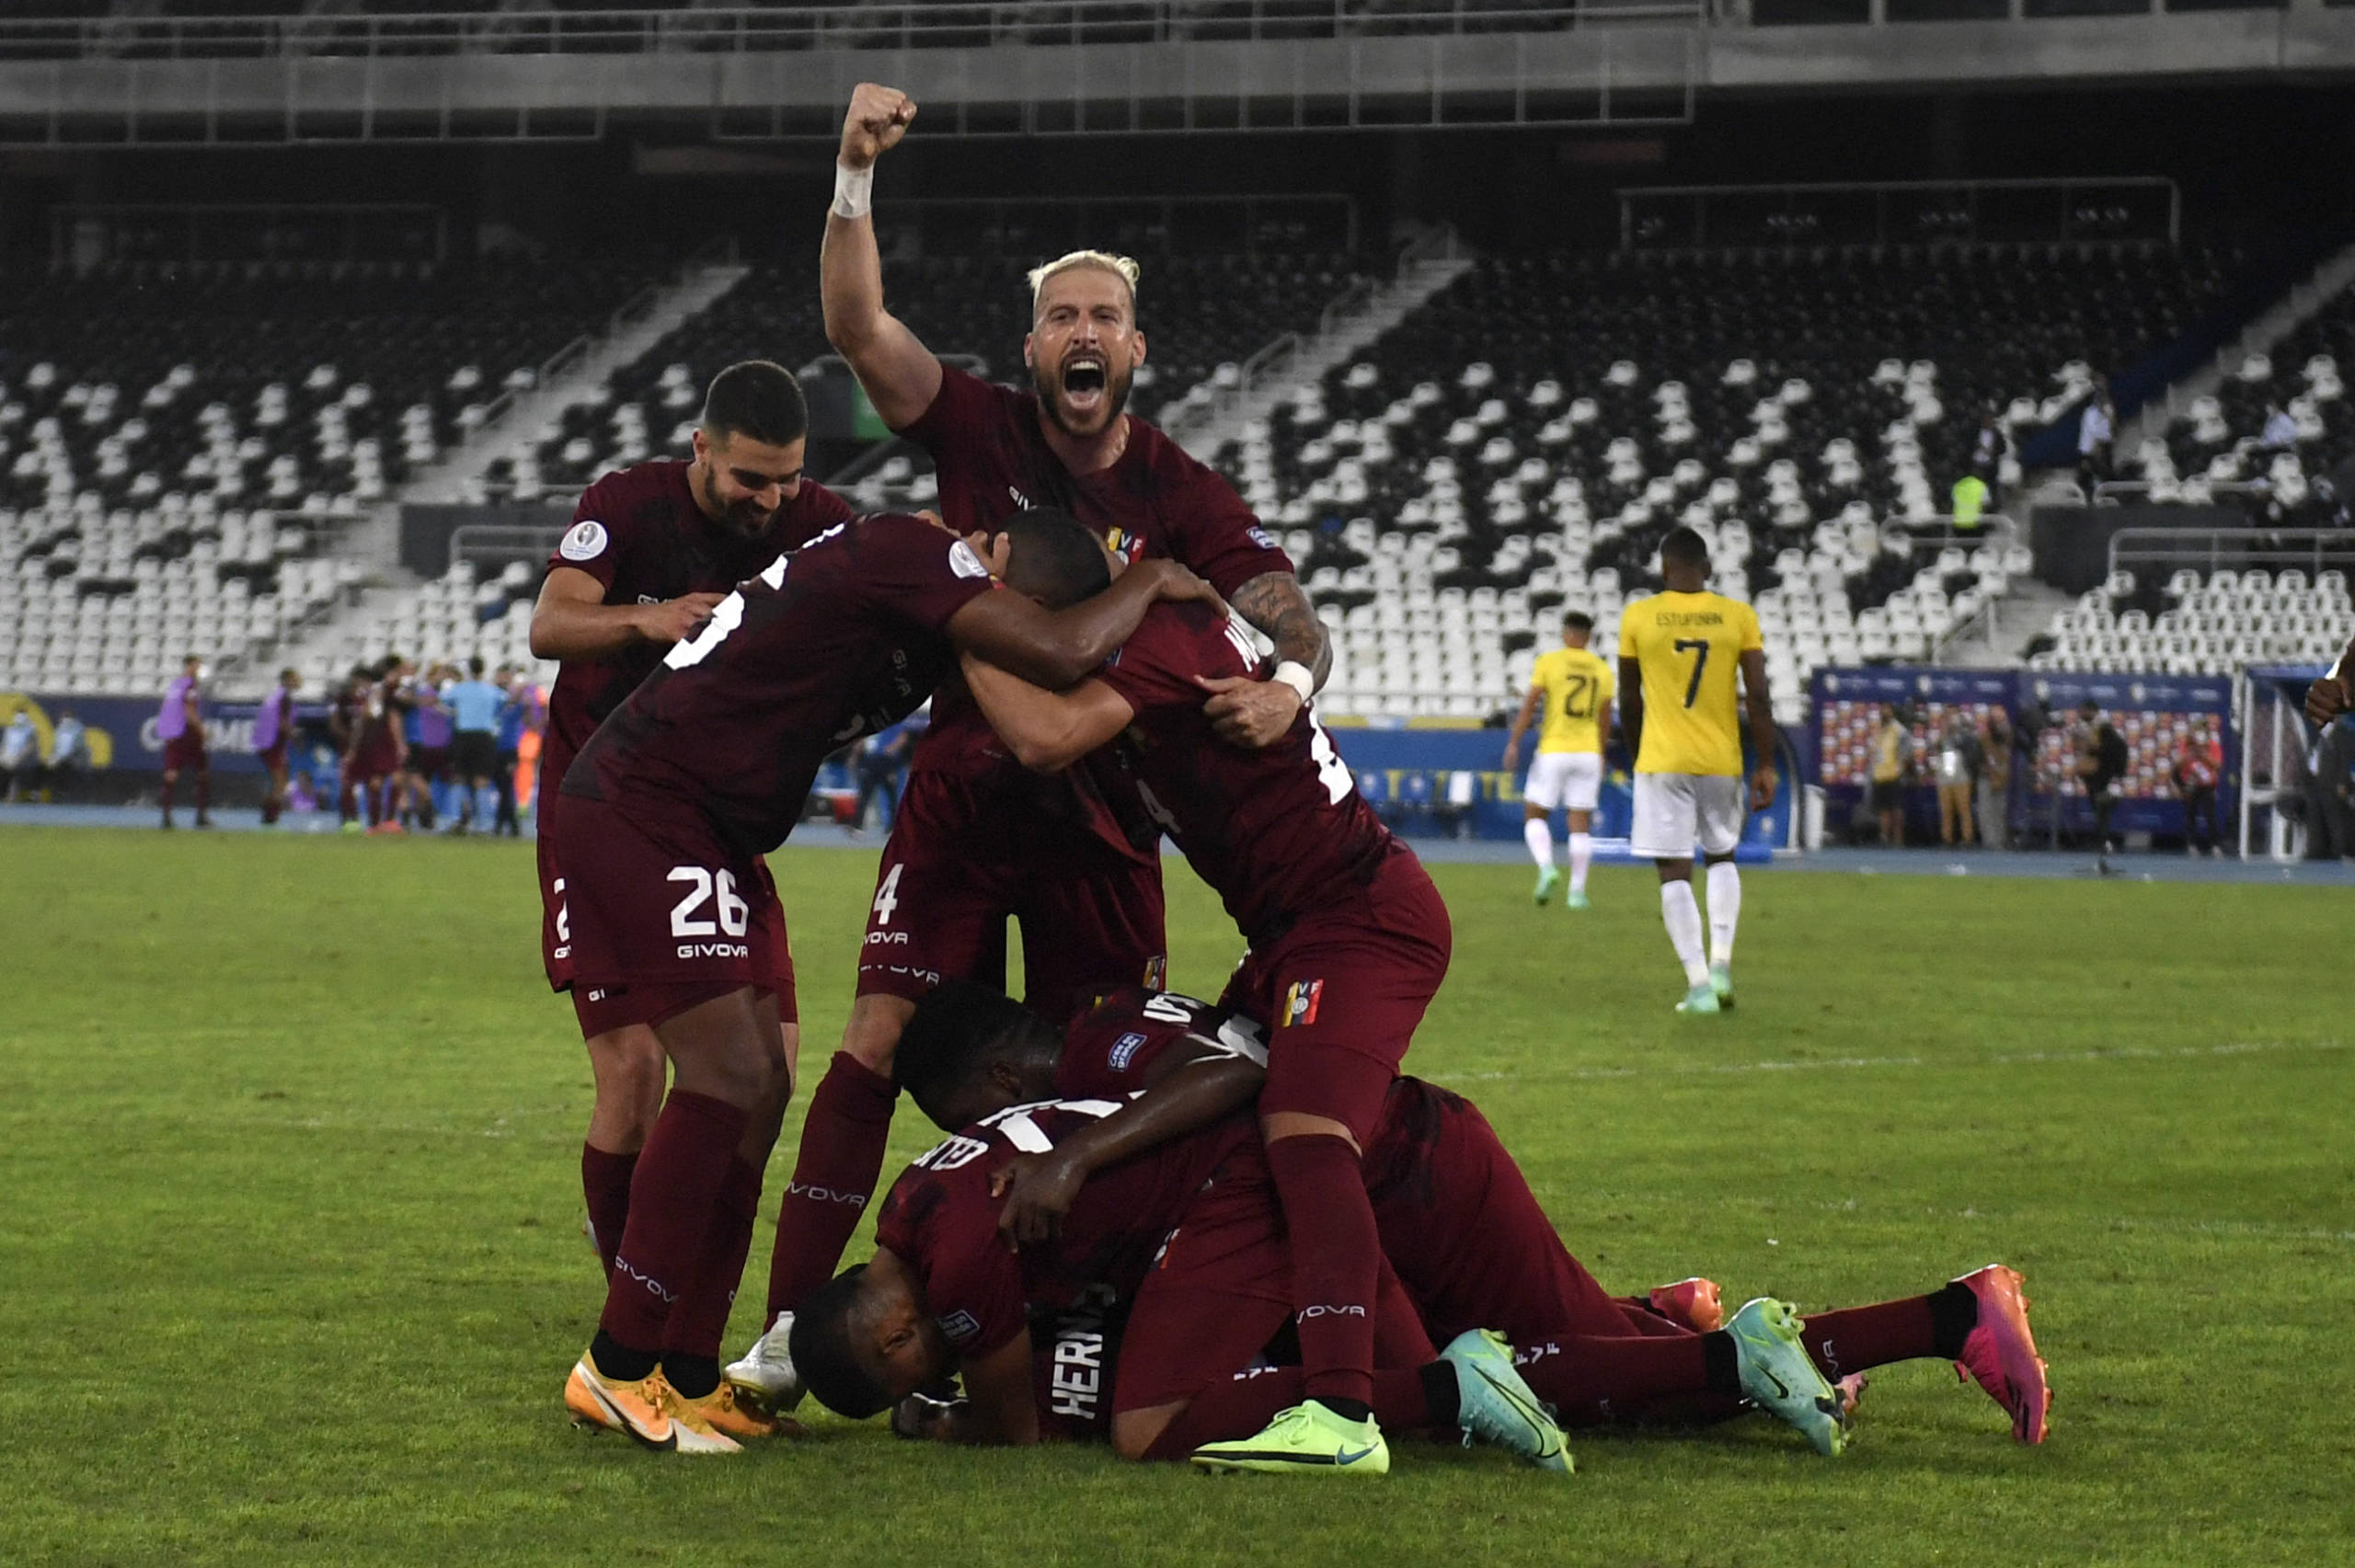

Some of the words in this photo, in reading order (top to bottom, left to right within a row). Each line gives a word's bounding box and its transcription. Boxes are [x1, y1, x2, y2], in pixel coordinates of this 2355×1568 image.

[1565, 674, 1599, 717] 21
[1674, 638, 1709, 709] 7
[666, 866, 749, 936] 26
[873, 863, 904, 925] 4
[677, 944, 749, 959] GIVOVA
